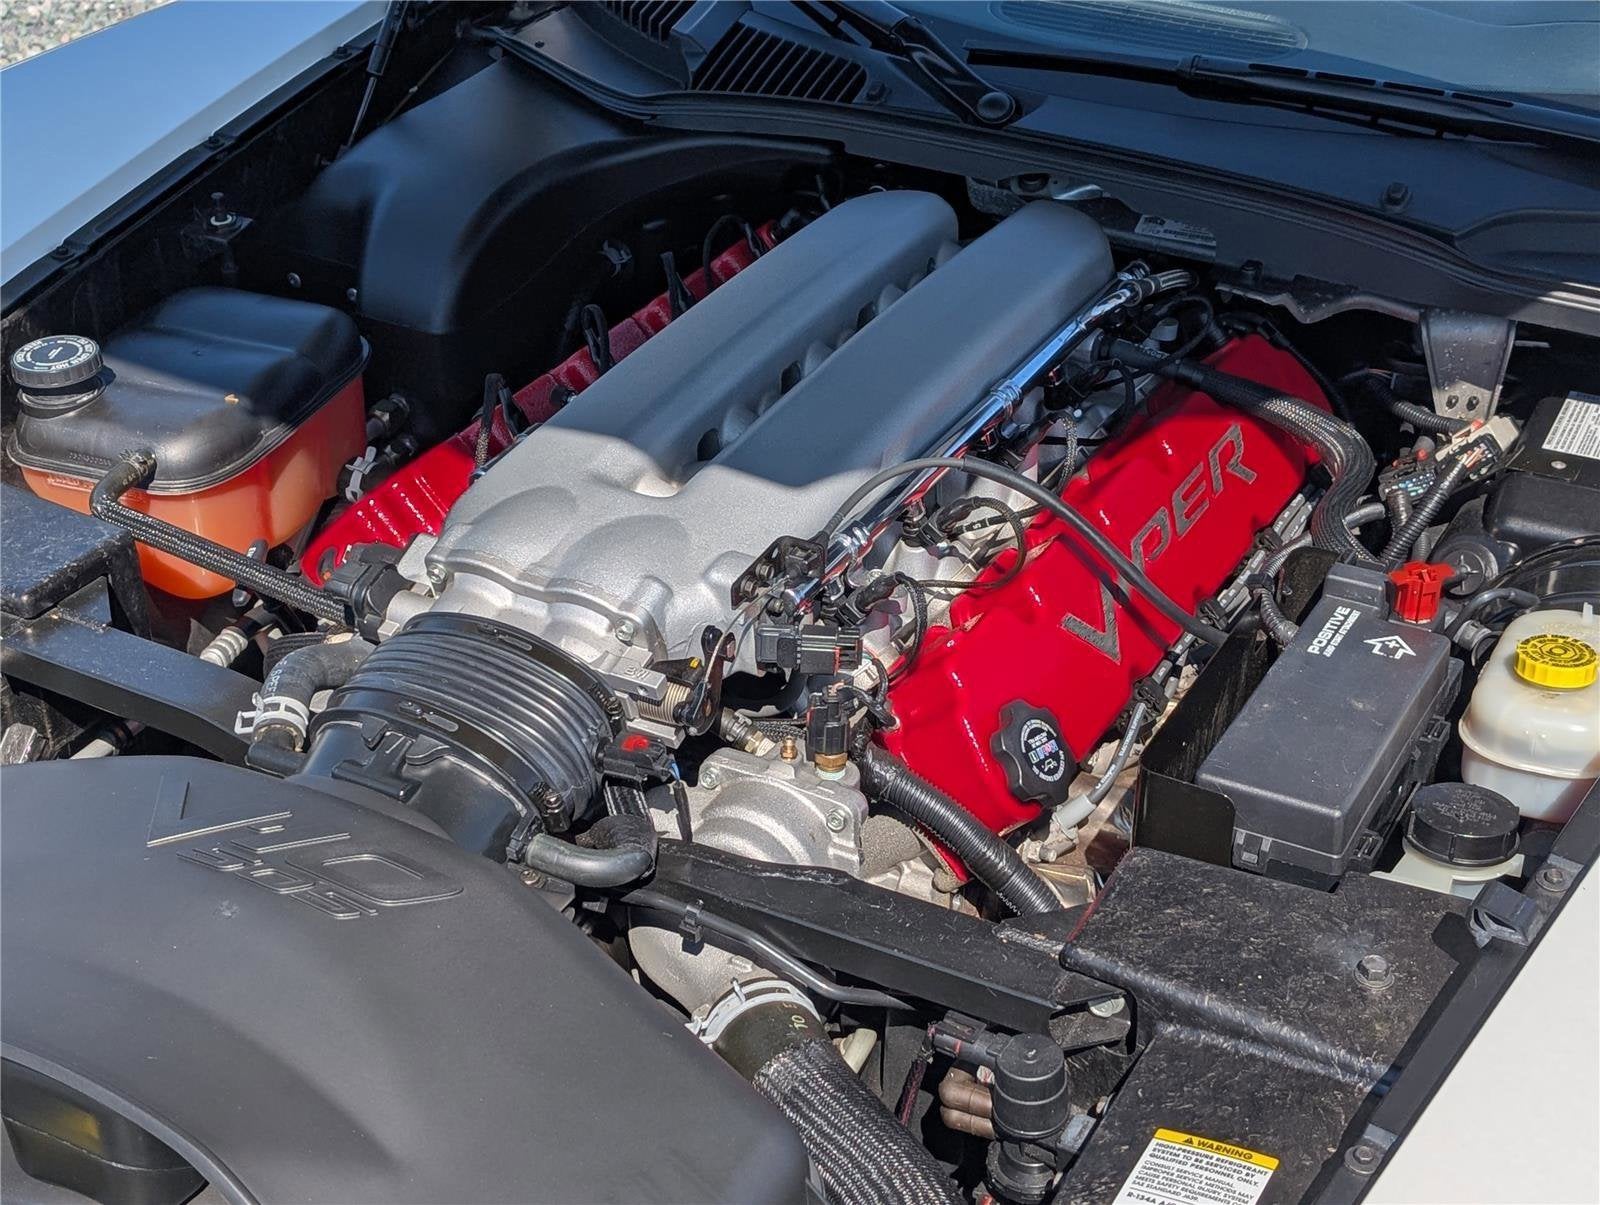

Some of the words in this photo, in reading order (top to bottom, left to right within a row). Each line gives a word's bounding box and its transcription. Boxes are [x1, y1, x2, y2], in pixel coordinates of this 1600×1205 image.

[1307, 606, 1351, 654] POSITIVE
[1152, 1147, 1180, 1158] SYSTEM
[1205, 1161, 1243, 1175] SERVICED
[1155, 1142, 1213, 1160] HIGH-PRESSURE
[1215, 1158, 1268, 1175] REFRIGERANT
[1196, 1140, 1254, 1160] WARNING
[1141, 1164, 1174, 1177] IMPROPER
[1176, 1174, 1203, 1185] SERVICE
[1204, 1182, 1236, 1194] METHODS
[1144, 1159, 1174, 1171] CONSULT
[1175, 1168, 1203, 1179] SERVICE
[1149, 1152, 1188, 1166] QUALIFIED
[1189, 1163, 1234, 1179] PERSONNEL
[1236, 1176, 1260, 1187] ONLY.
[1126, 1191, 1156, 1204] R-134A
[1135, 1175, 1155, 1184] MEETS
[1156, 1180, 1180, 1190] SAFETY
[1180, 1187, 1230, 1205] REQUIREMENTS
[1138, 1170, 1160, 1179] CAUSE
[1161, 1176, 1196, 1189] PERSONAL
[1222, 1193, 1248, 1204] SYSTEM
[1146, 1183, 1181, 1197] STANDARD
